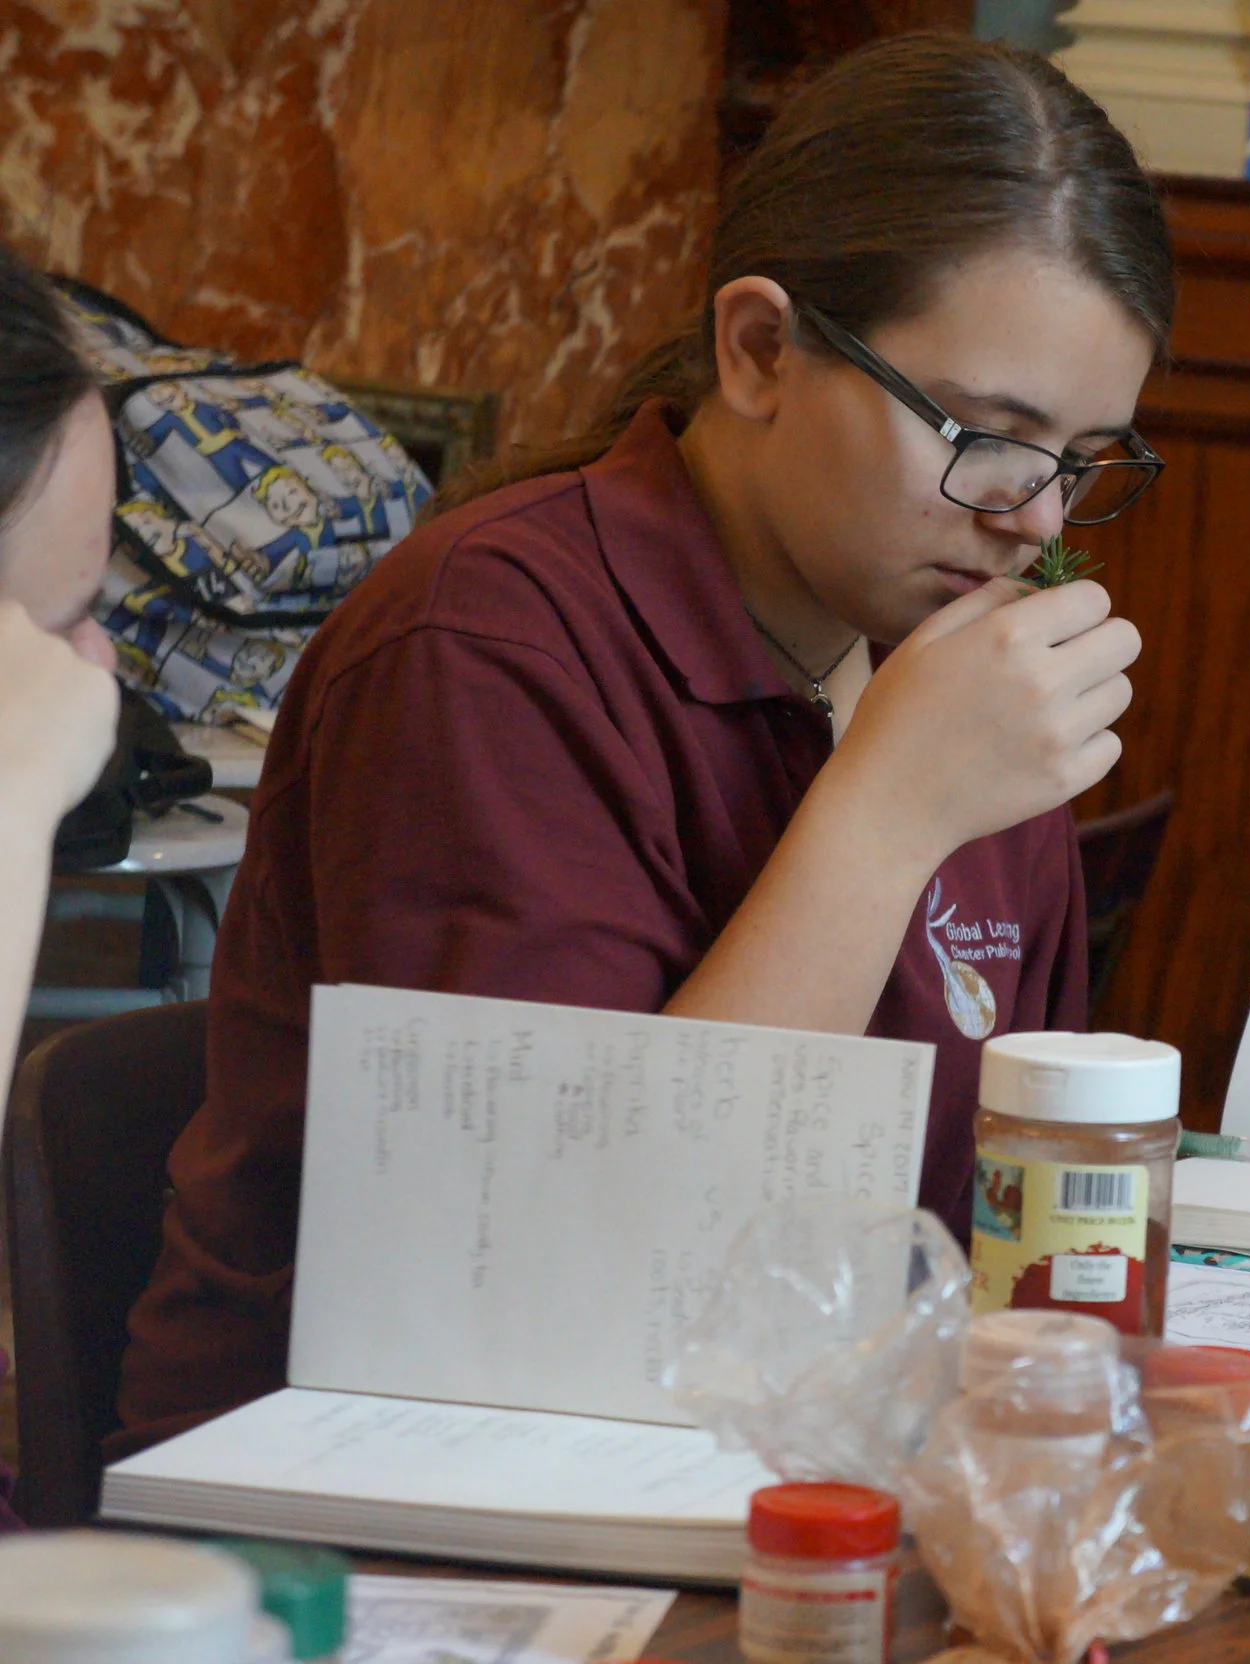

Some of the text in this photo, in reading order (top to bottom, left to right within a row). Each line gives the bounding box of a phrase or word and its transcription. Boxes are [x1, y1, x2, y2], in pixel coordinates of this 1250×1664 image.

[945, 922, 983, 942] Global
[713, 1037, 742, 1122] herb
[810, 1055, 841, 1131] Spice
[851, 1122, 884, 1200] Spice
[892, 1142, 914, 1193] 2017
